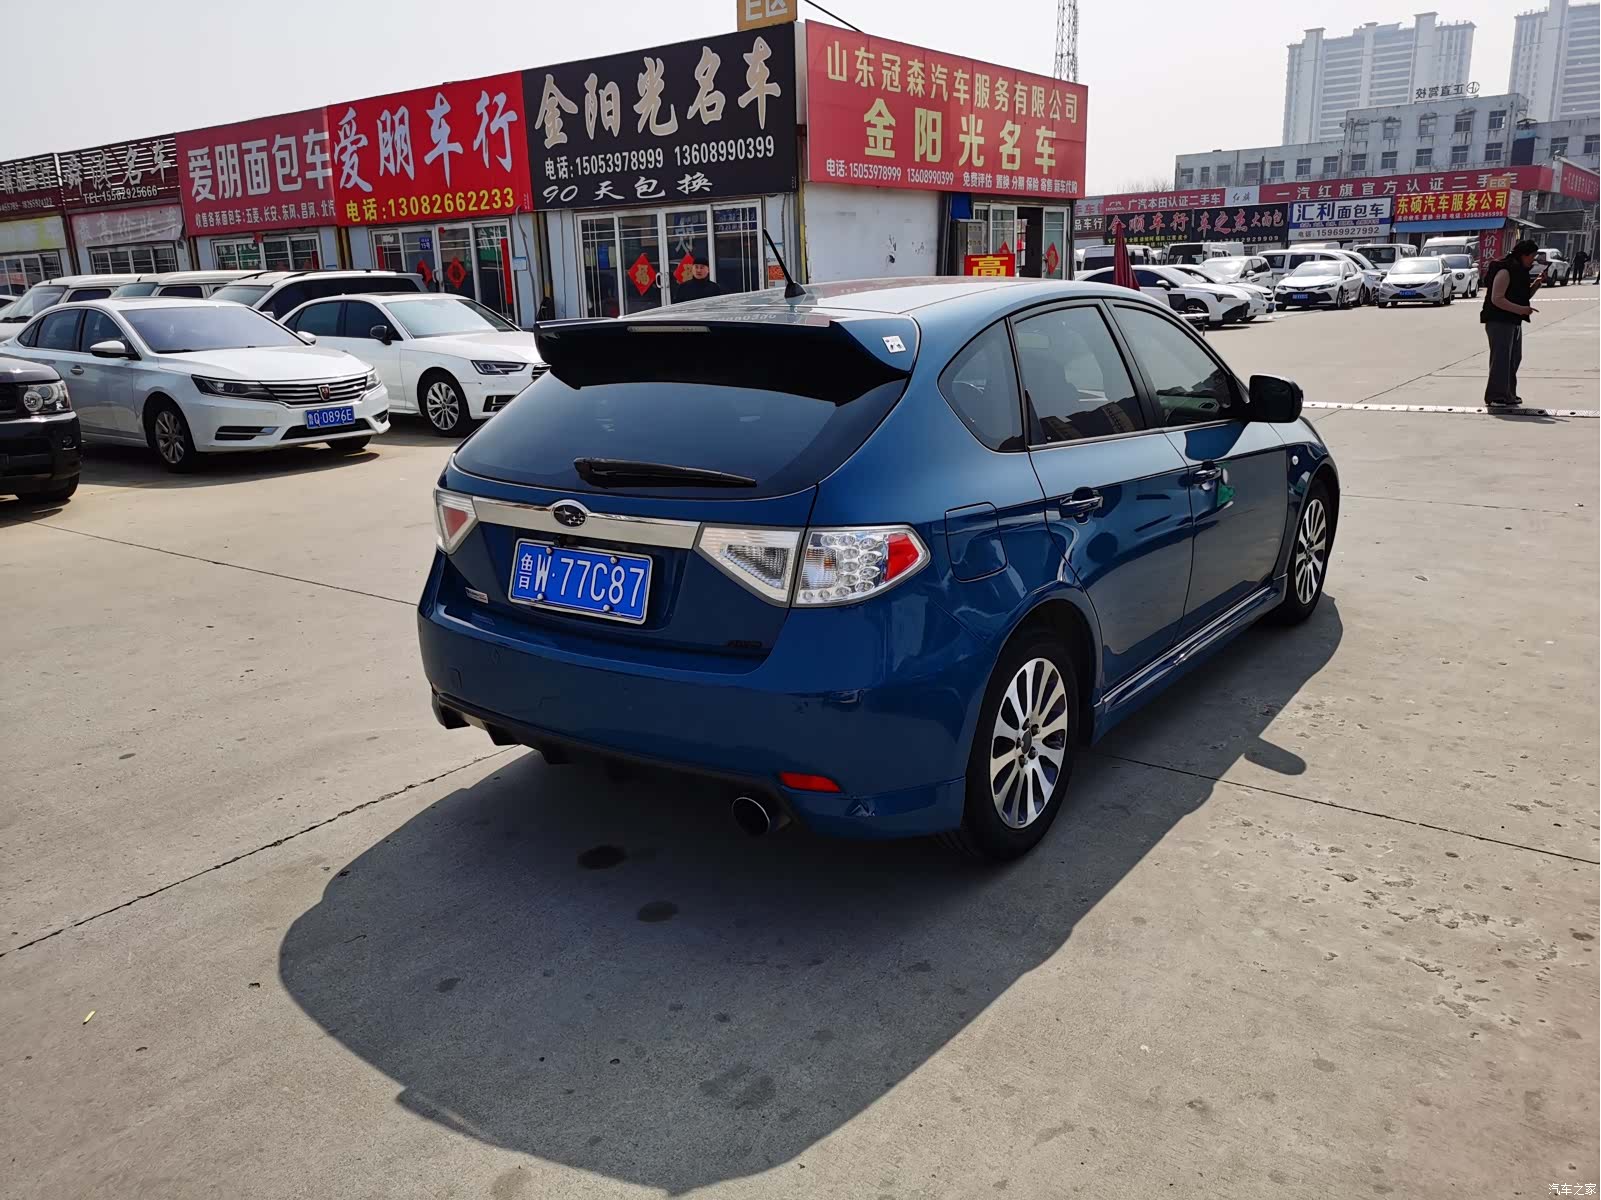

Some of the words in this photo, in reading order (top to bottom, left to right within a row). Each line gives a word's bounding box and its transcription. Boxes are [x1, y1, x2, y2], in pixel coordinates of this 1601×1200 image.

[535, 36, 782, 149] 金阳光名车
[827, 41, 1078, 124] 山东冠森汽车服务有限公司
[333, 90, 518, 193] 爱朋车行
[674, 135, 775, 167] 13608990399
[864, 98, 1056, 175] 金阳光名车
[187, 128, 333, 203] 爱朋面包车
[907, 168, 954, 185] 13608990399
[963, 171, 993, 188] 免费评估
[1127, 193, 1220, 211] 广汽本田认证二手车
[1297, 202, 1384, 221] 汇利面包车
[1397, 191, 1508, 214] 东硕汽车服务公司
